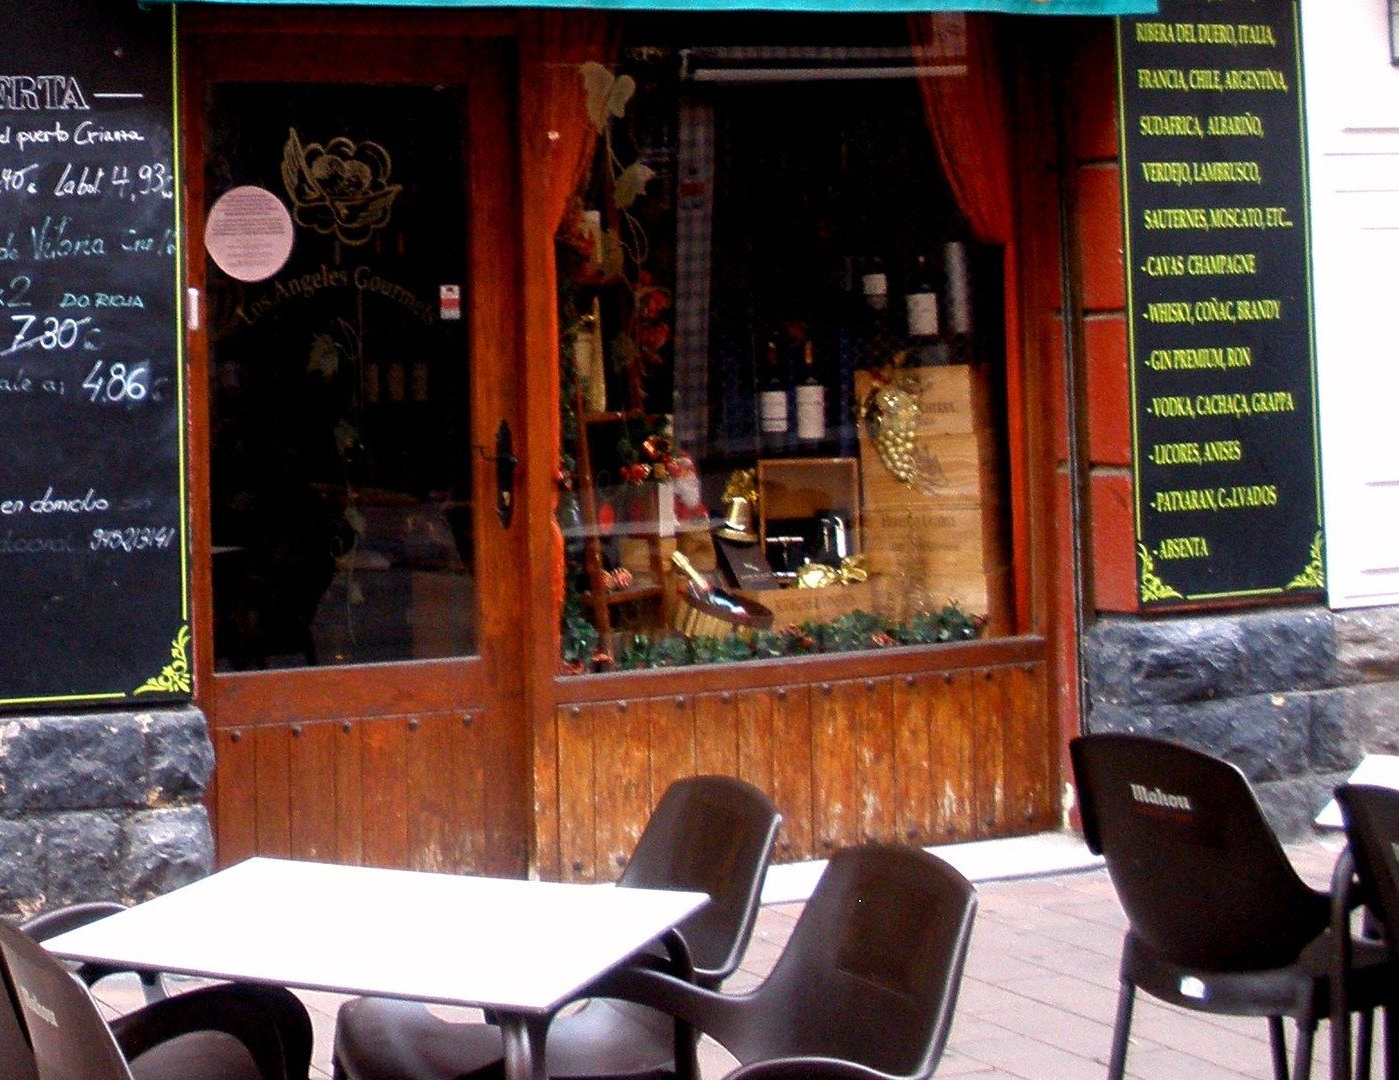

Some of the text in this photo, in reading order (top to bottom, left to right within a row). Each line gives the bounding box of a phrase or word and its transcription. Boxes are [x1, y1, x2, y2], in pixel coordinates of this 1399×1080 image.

[1136, 23, 1175, 43] RIBERA
[1177, 23, 1195, 42] DEL
[16, 121, 69, 151] puerto
[1187, 254, 1256, 275] CHAMPAGNE
[1237, 300, 1281, 321] BRANDY
[1228, 347, 1251, 368] RON
[1252, 391, 1295, 413] GRAPPA
[1204, 440, 1242, 462] ANISES
[0, 499, 24, 515] en
[1129, 783, 1192, 810] Mahou
